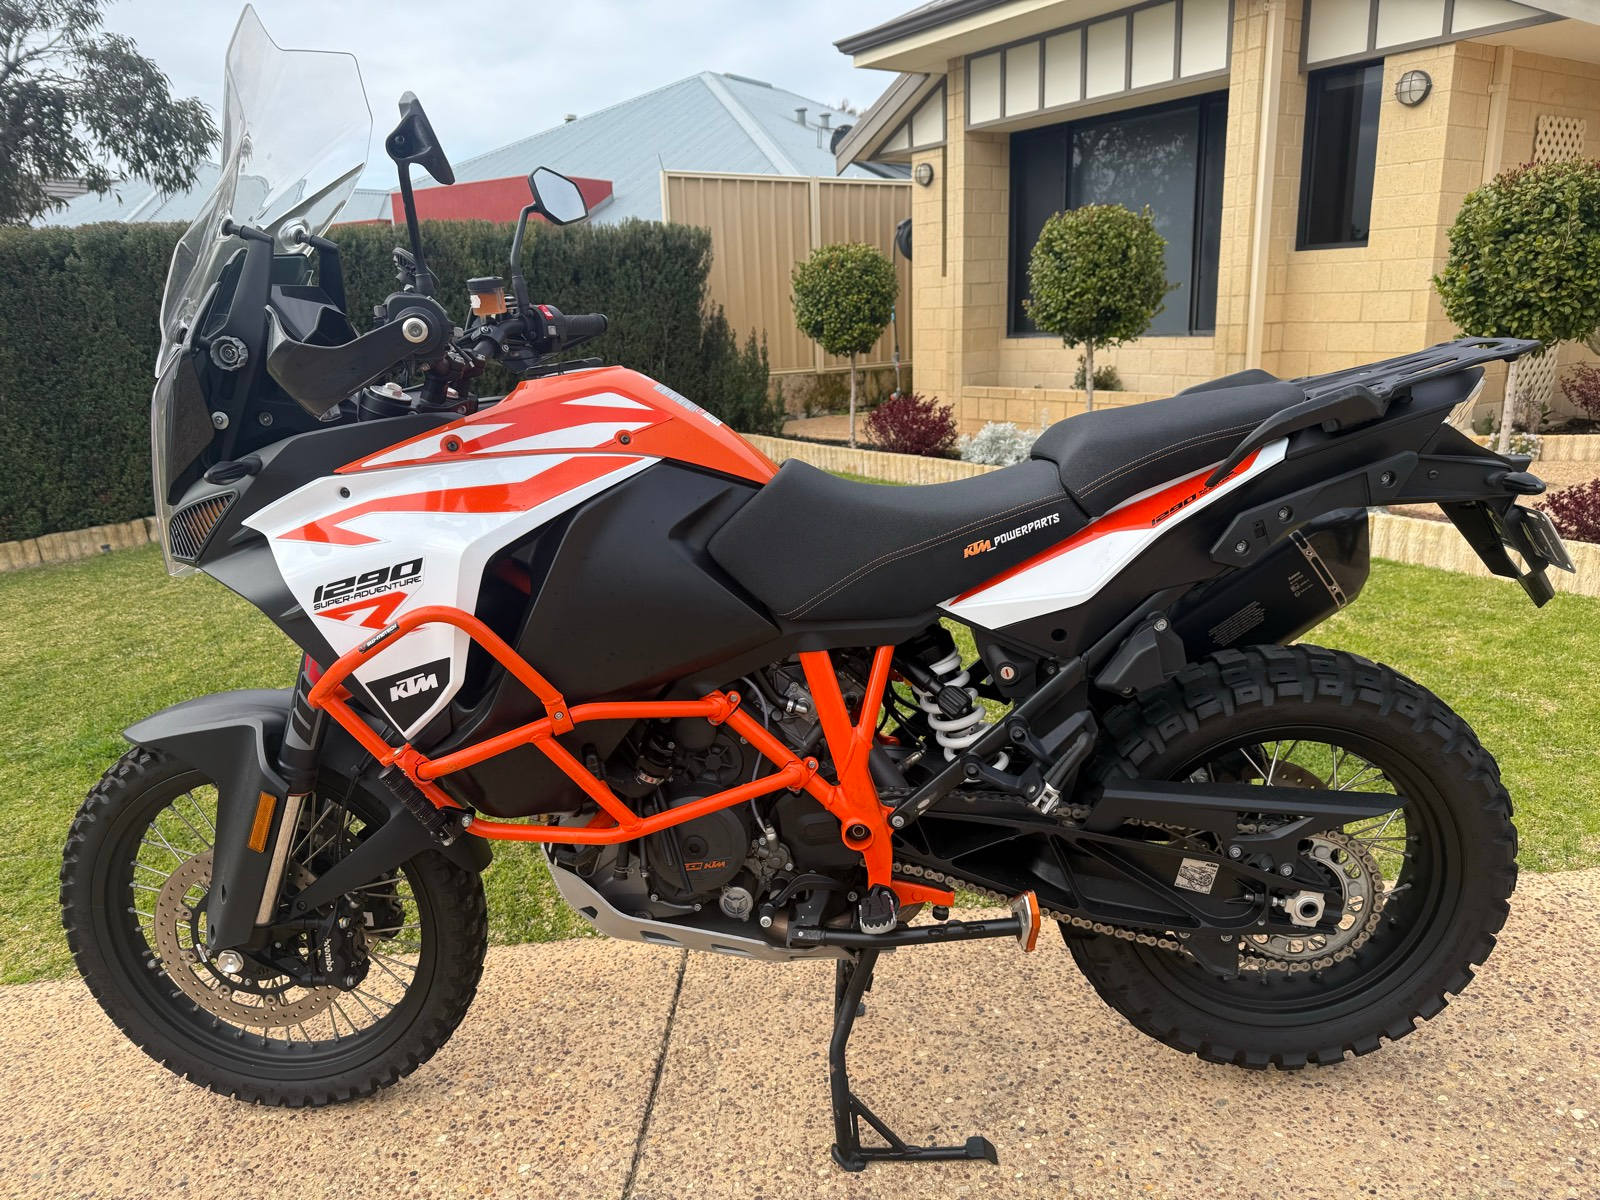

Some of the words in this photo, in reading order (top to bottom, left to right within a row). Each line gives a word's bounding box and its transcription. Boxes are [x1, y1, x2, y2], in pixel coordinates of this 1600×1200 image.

[1151, 493, 1197, 527] 1290
[313, 557, 423, 603] 1290
[313, 575, 422, 611] SUPER-ADVENTURE
[389, 673, 439, 702] KTM
